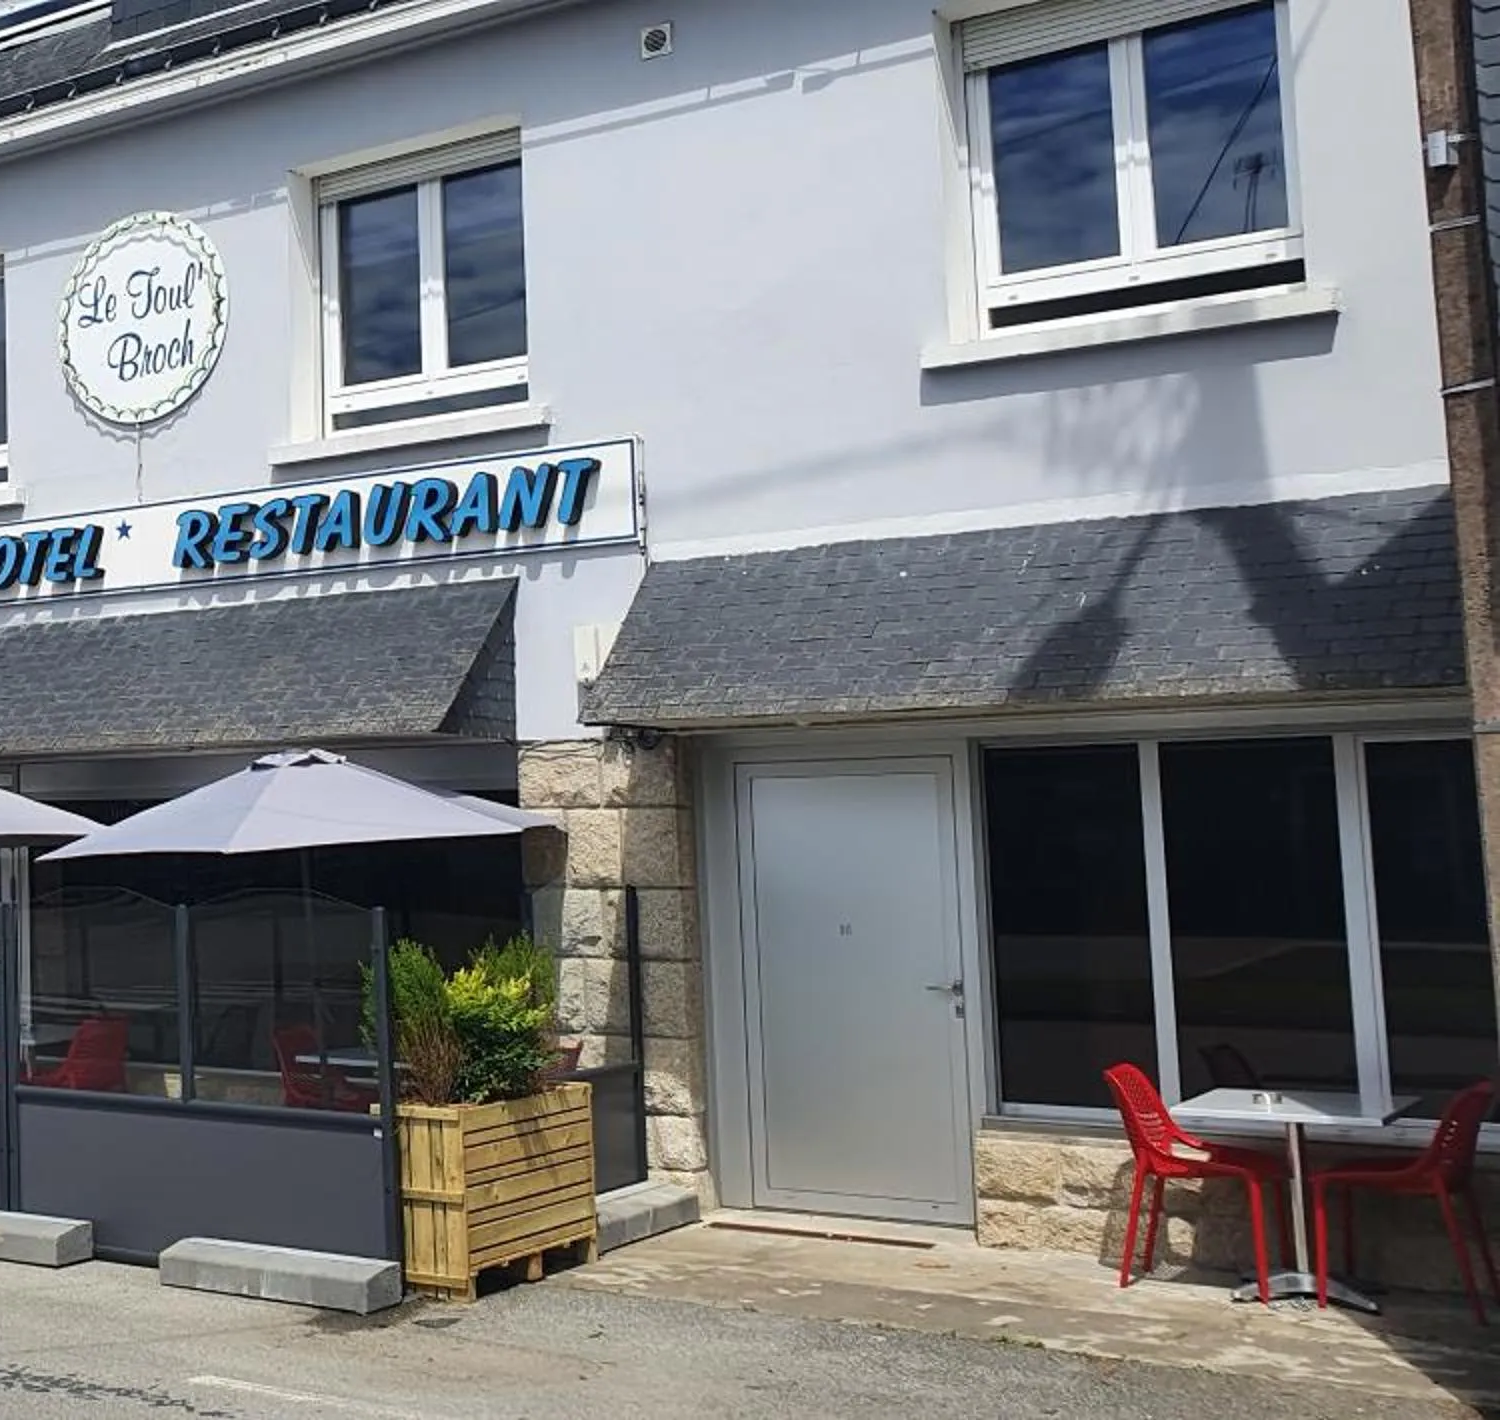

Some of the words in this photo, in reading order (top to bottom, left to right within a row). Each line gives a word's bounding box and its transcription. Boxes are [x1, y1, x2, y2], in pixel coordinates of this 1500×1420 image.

[78, 275, 117, 328] Le
[126, 261, 203, 319] Toul'
[107, 318, 194, 382] Broch
[172, 457, 602, 569] RESTAURANT
